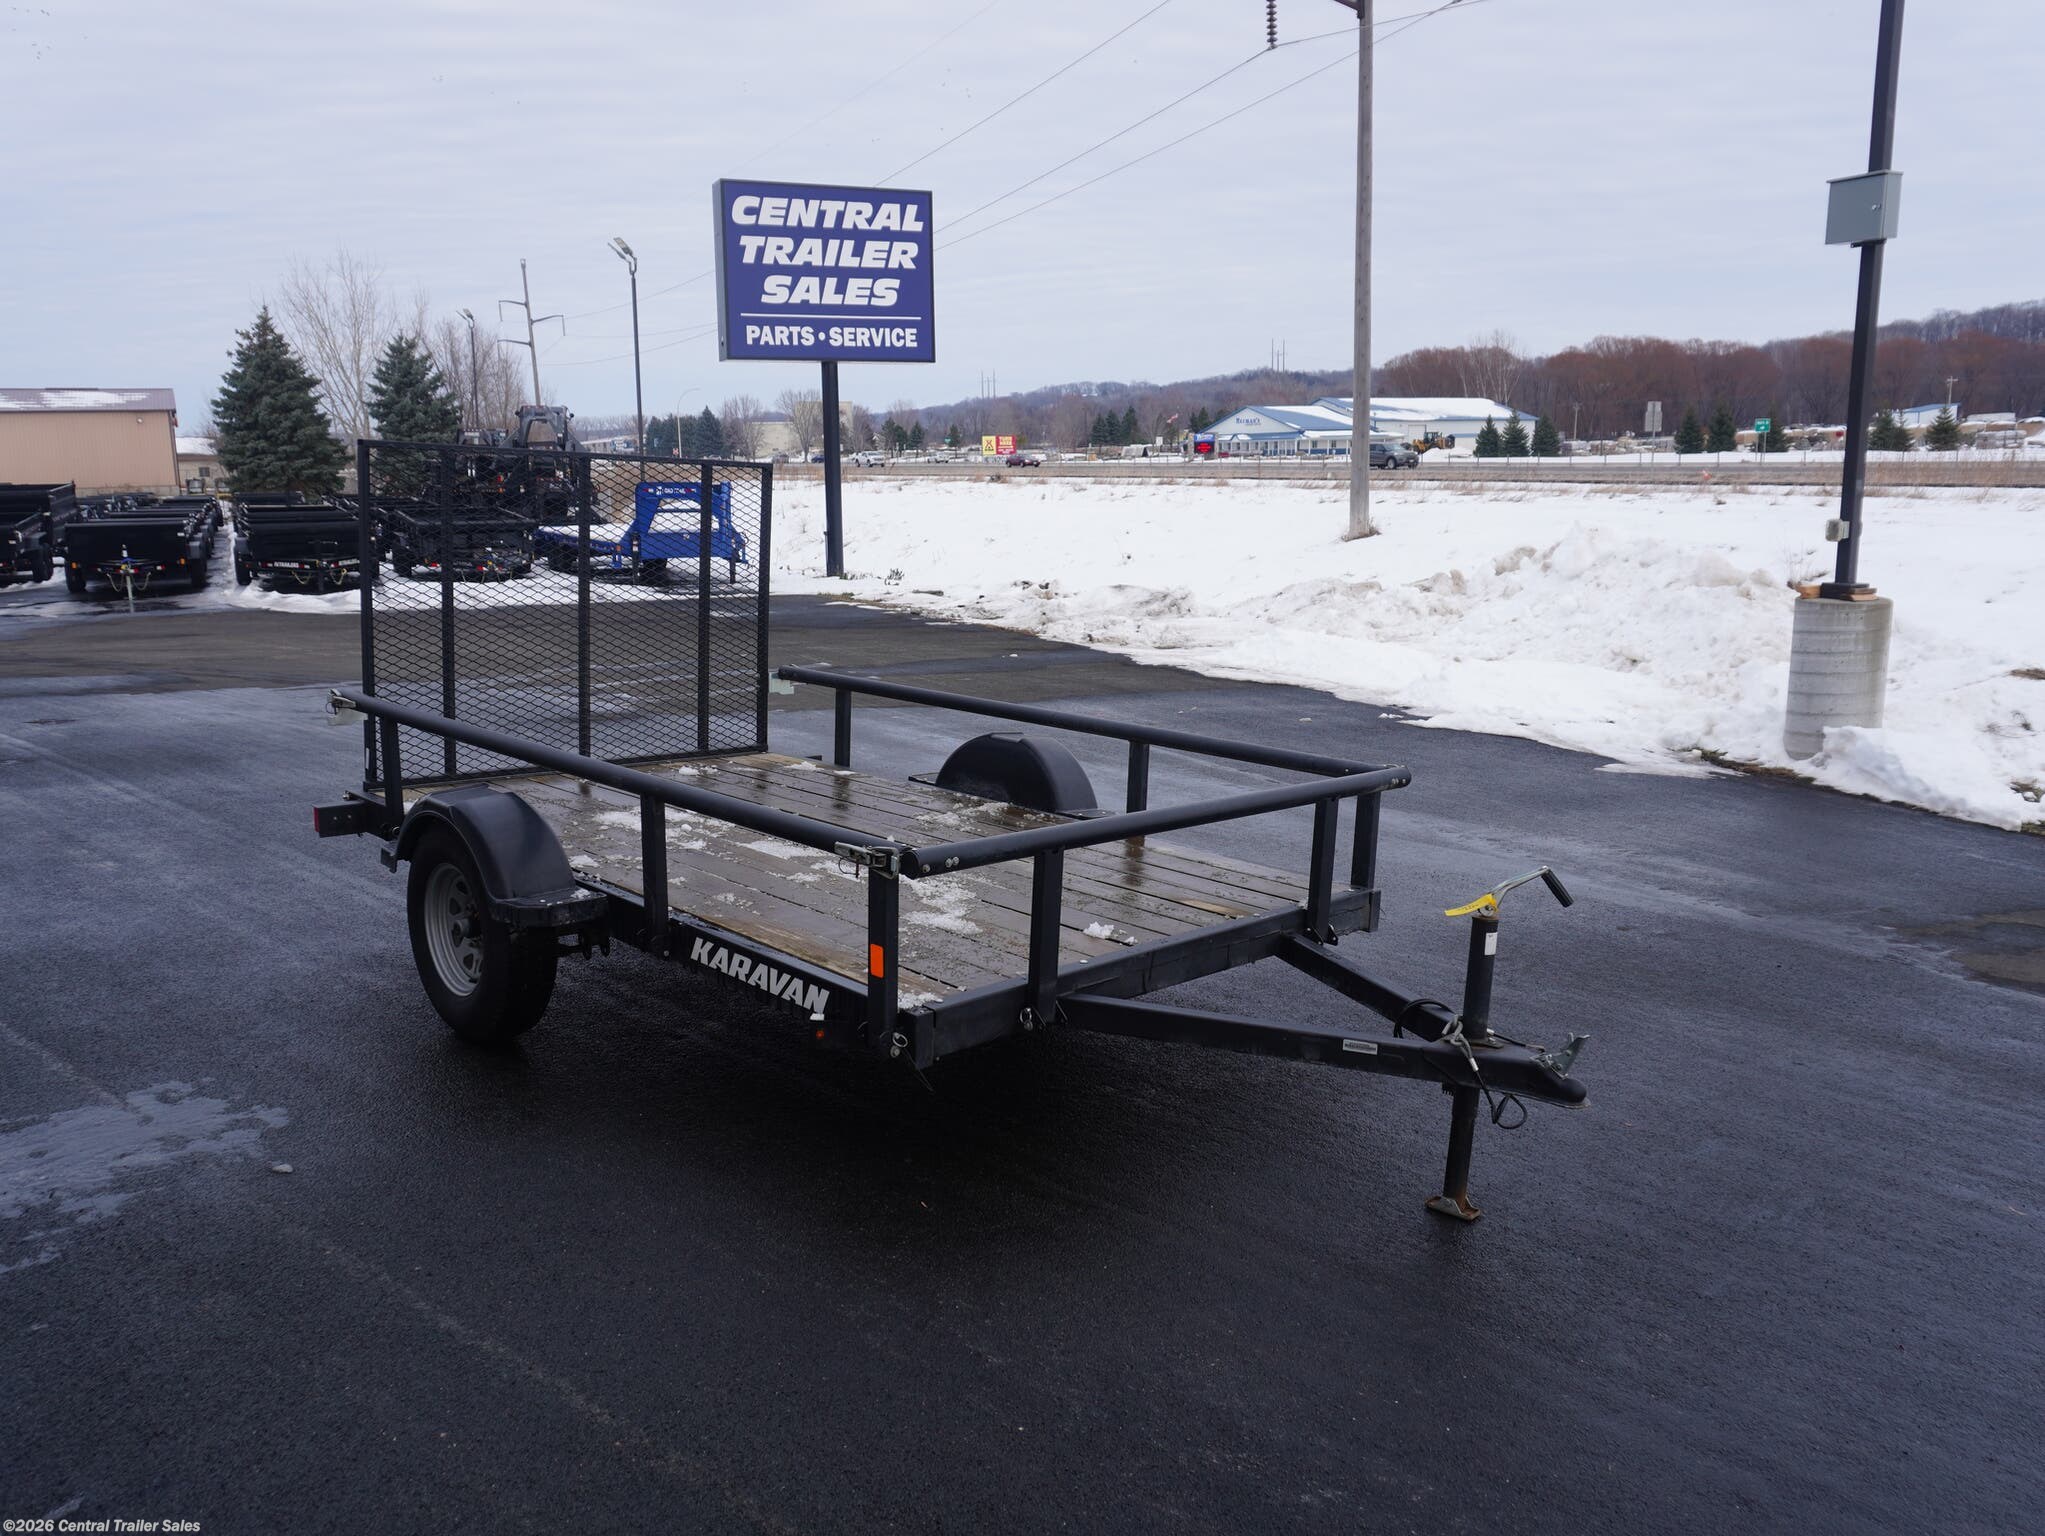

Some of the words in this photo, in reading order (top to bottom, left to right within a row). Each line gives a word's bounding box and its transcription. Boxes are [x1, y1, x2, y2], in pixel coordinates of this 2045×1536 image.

[731, 195, 924, 232] CENTRAL
[739, 235, 919, 269] TRAILER
[760, 274, 901, 307] SALES
[746, 325, 815, 346] PARTS
[828, 327, 918, 348] SERVICE
[690, 936, 830, 1017] KARAVAN
